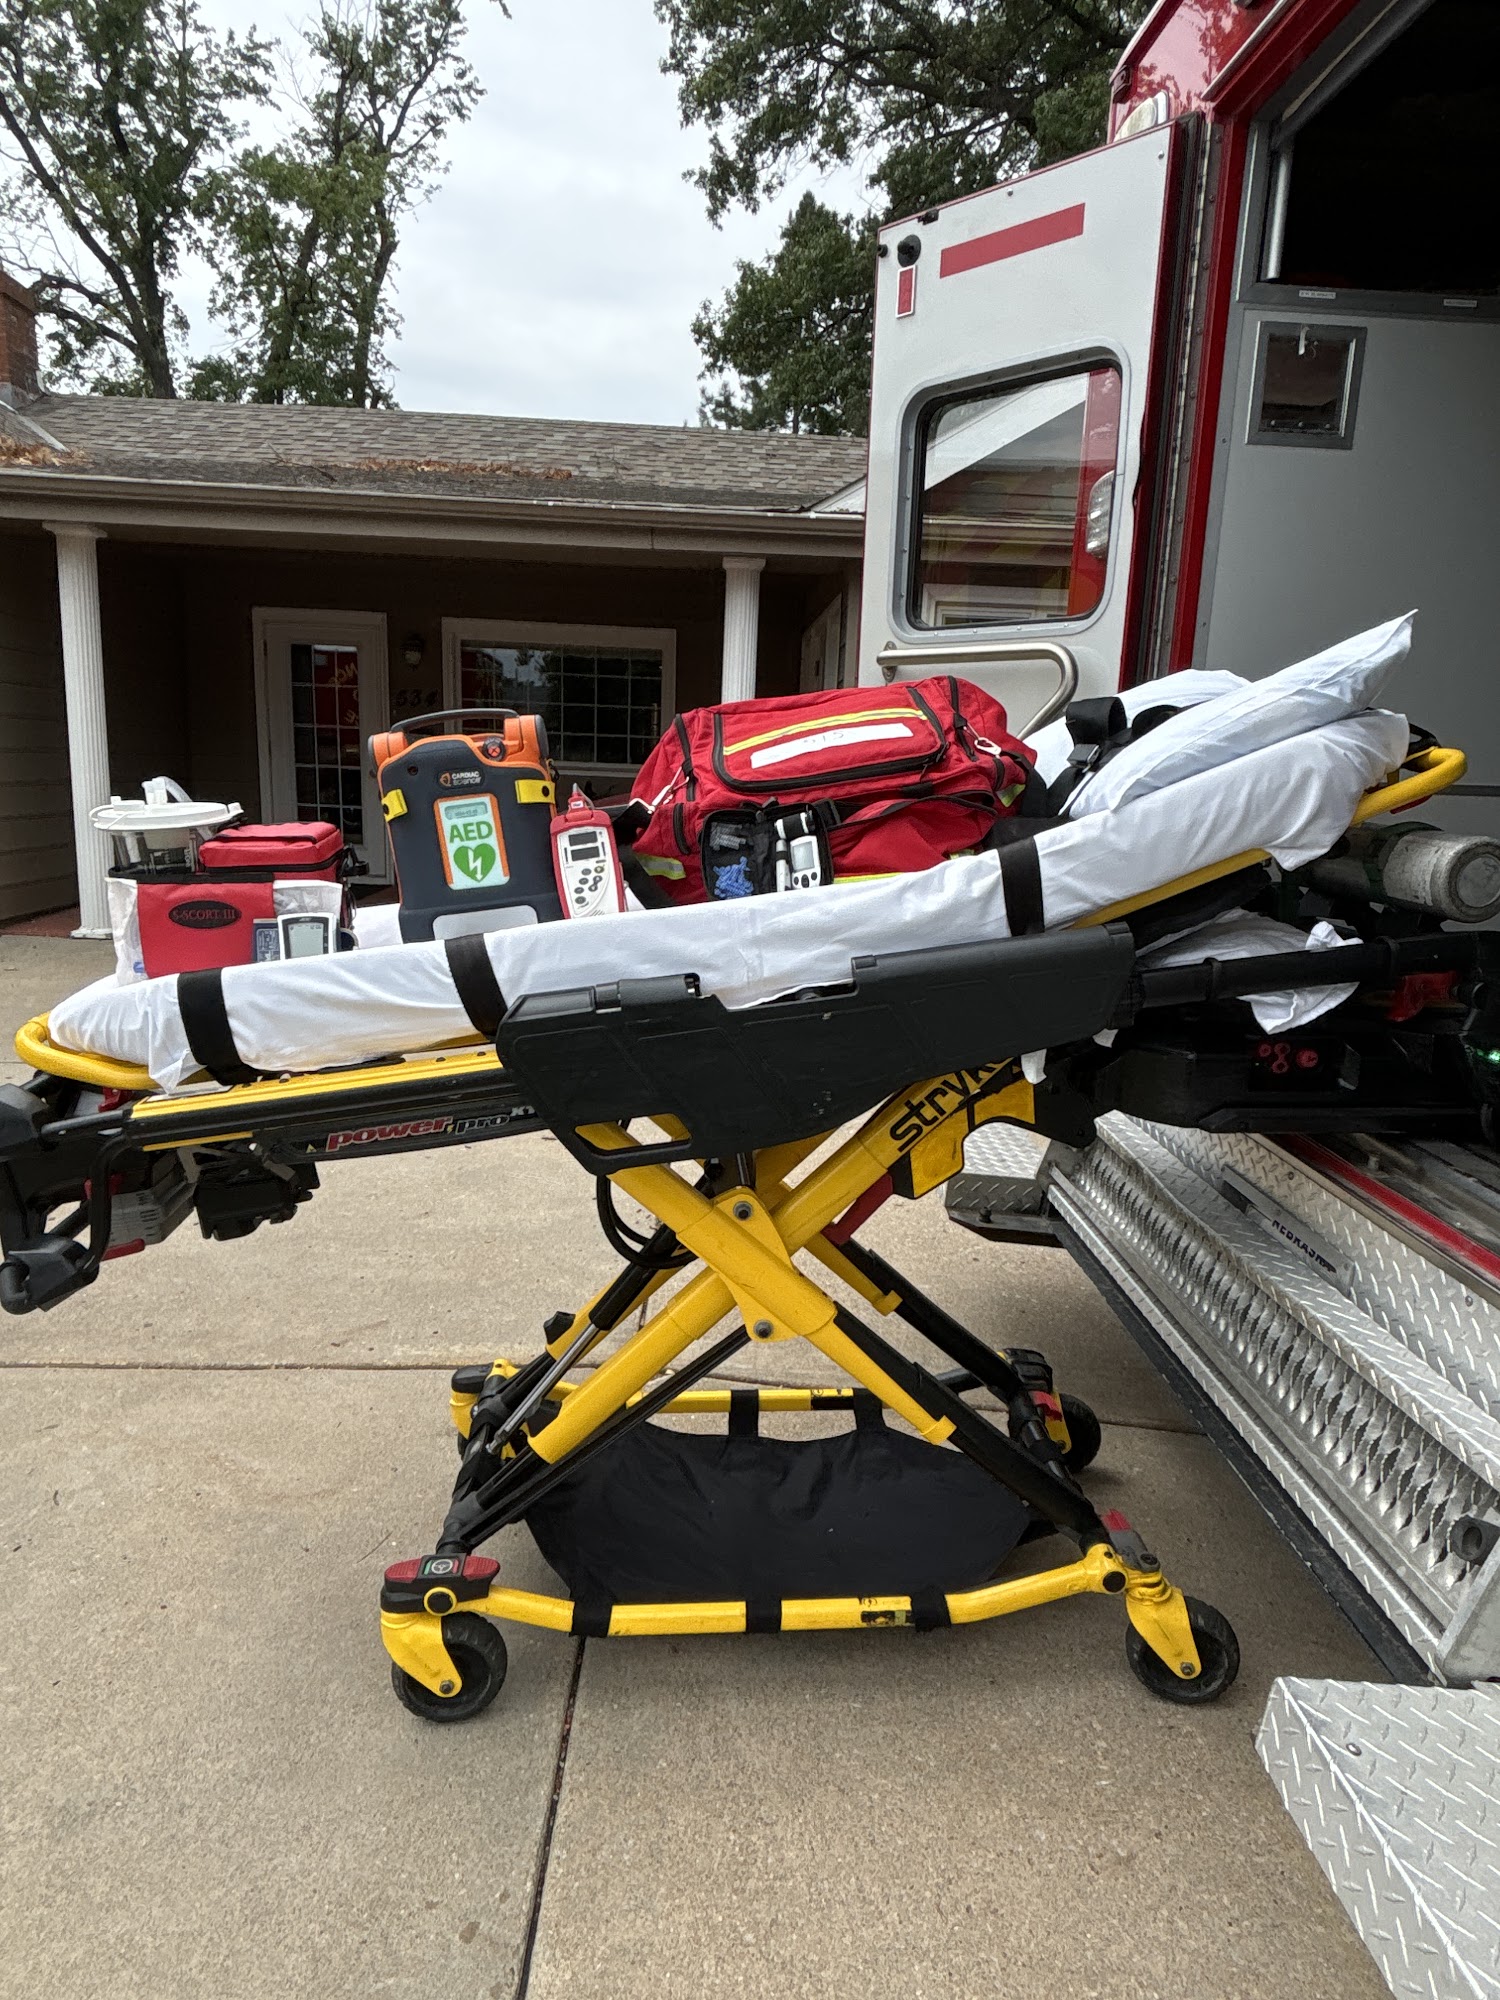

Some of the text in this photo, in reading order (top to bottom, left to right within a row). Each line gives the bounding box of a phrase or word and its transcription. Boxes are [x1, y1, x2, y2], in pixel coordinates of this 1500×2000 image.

[451, 771, 480, 780] CARDIAC
[449, 821, 493, 843] AED
[223, 908, 235, 919] III
[326, 1116, 453, 1152] power
[455, 1114, 510, 1135] pro
